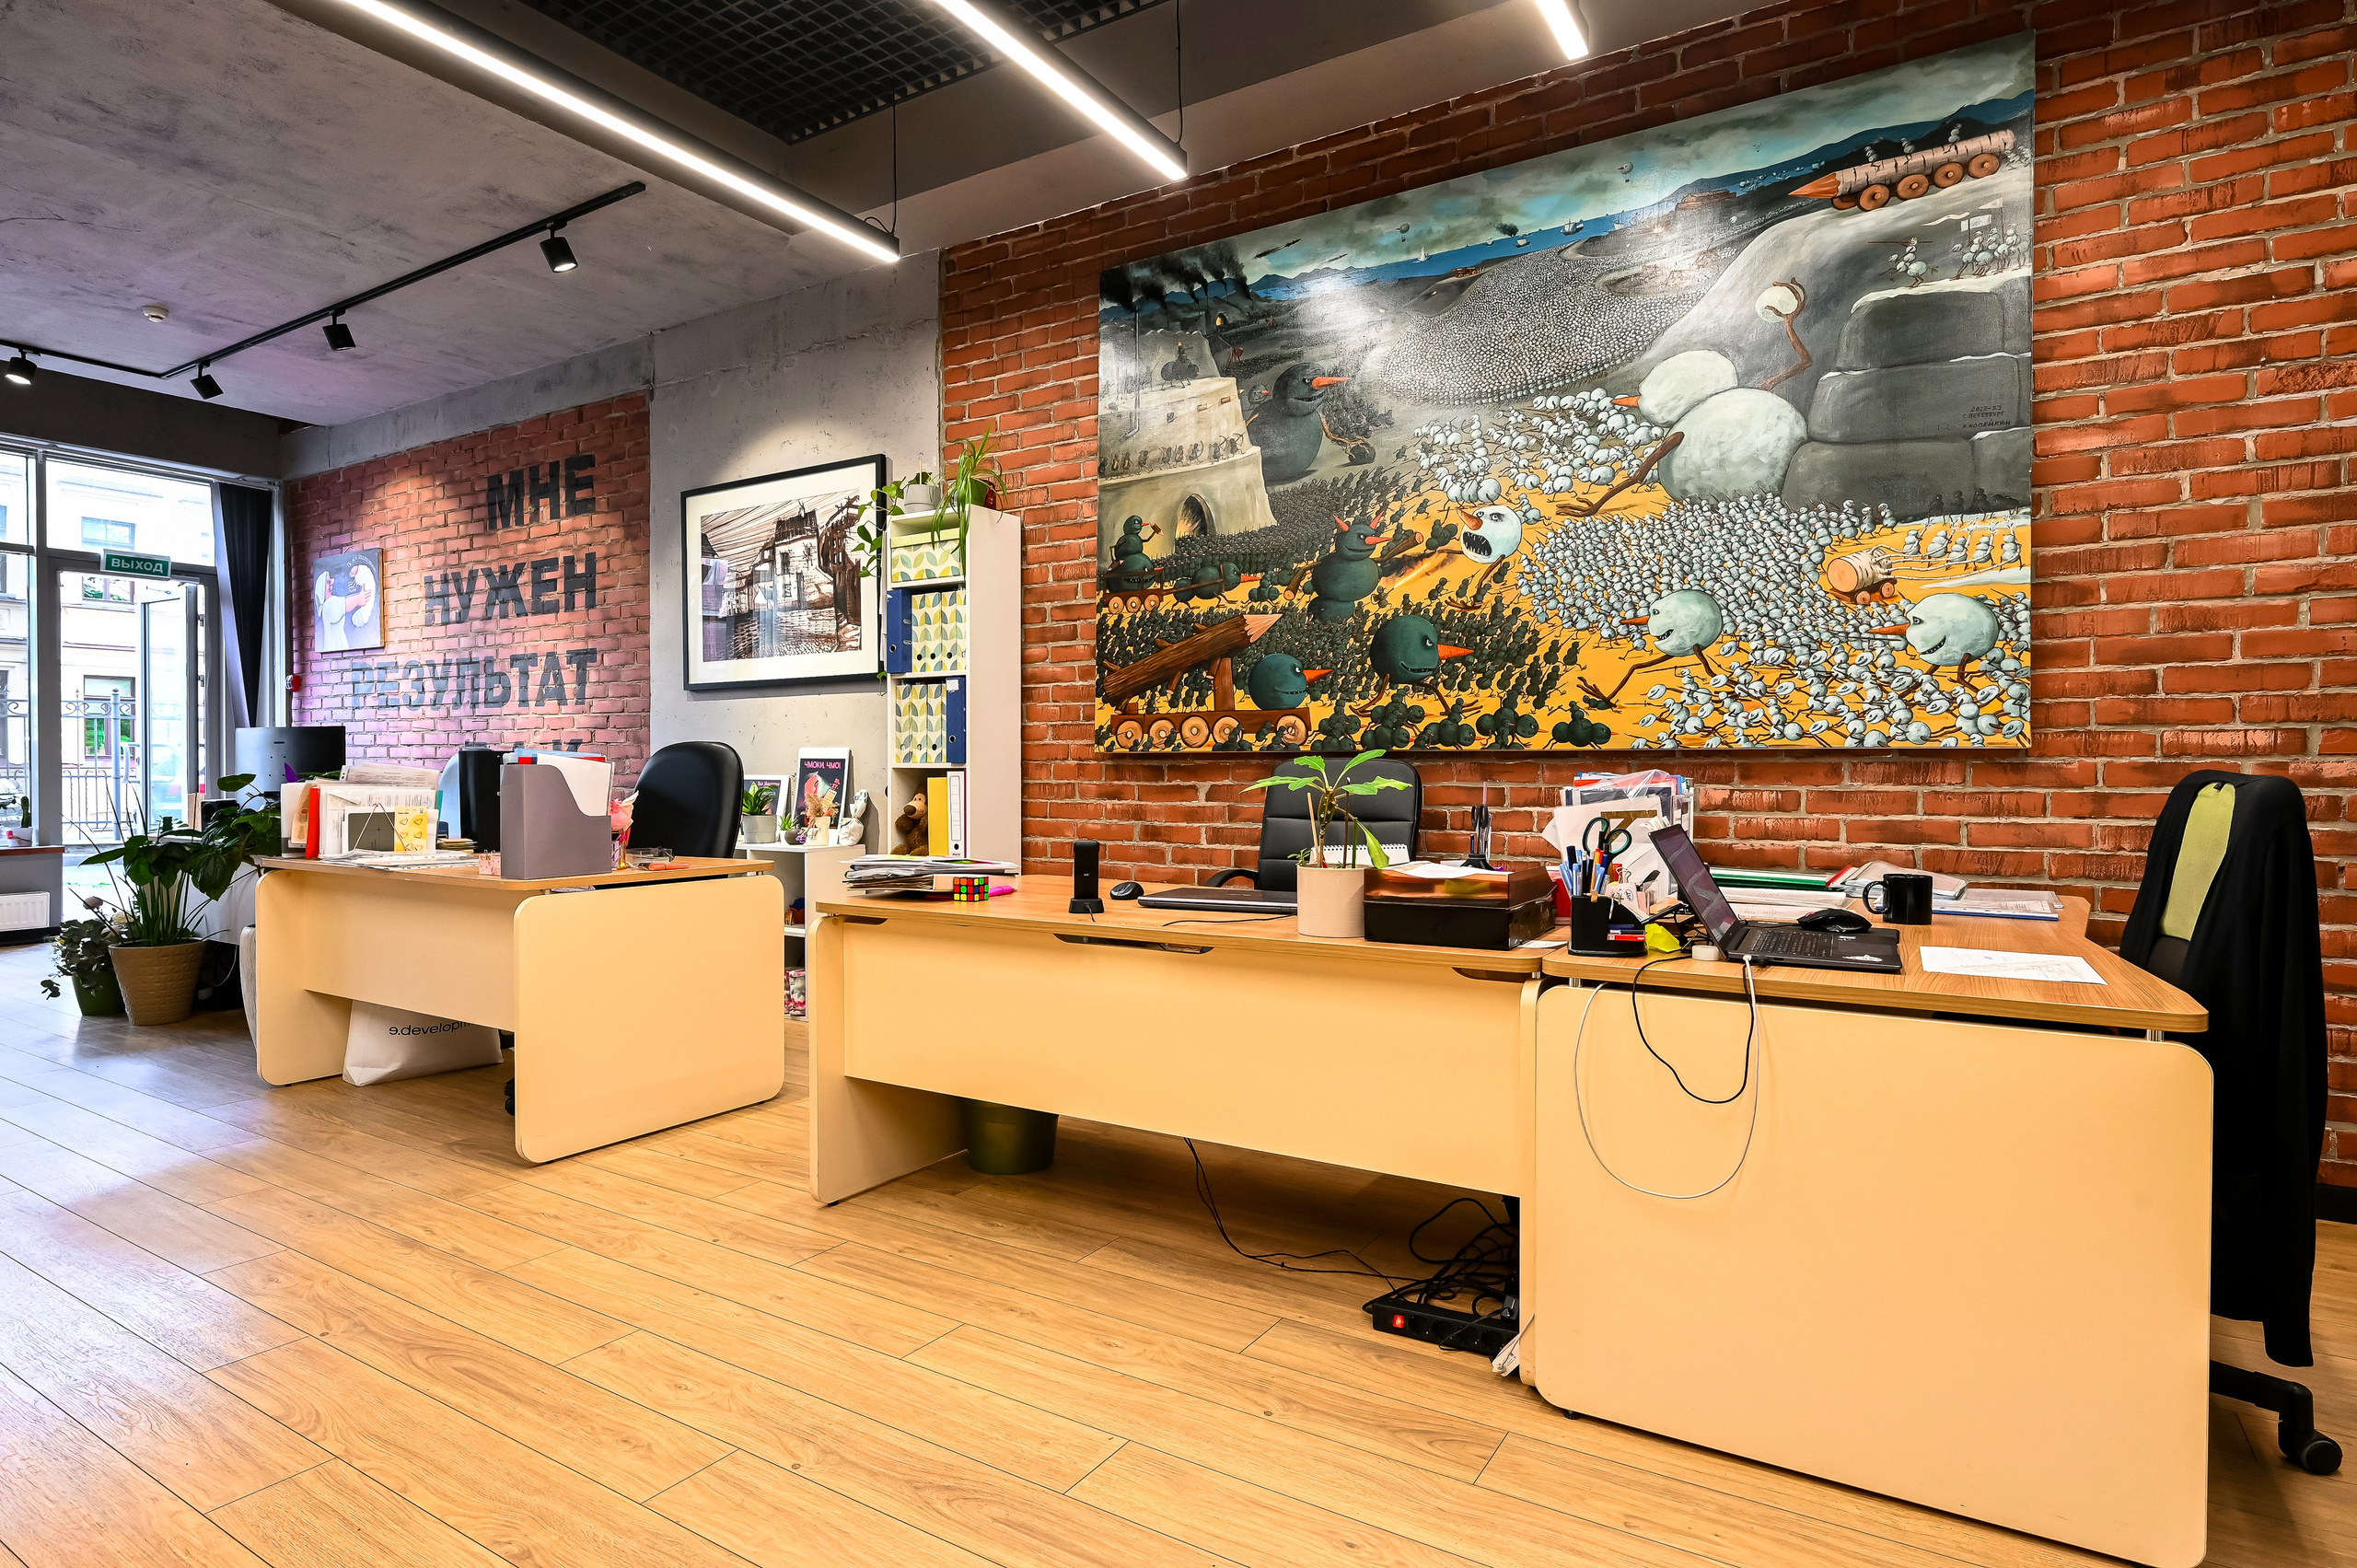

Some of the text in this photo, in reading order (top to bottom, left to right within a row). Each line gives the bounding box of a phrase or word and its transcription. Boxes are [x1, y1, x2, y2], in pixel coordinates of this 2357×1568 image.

[486, 454, 596, 530] МНЕ
[111, 558, 163, 574] ВЫХОД
[424, 552, 597, 626] НУЖЕН
[352, 648, 597, 711] РЕЗУЛЬТАТ
